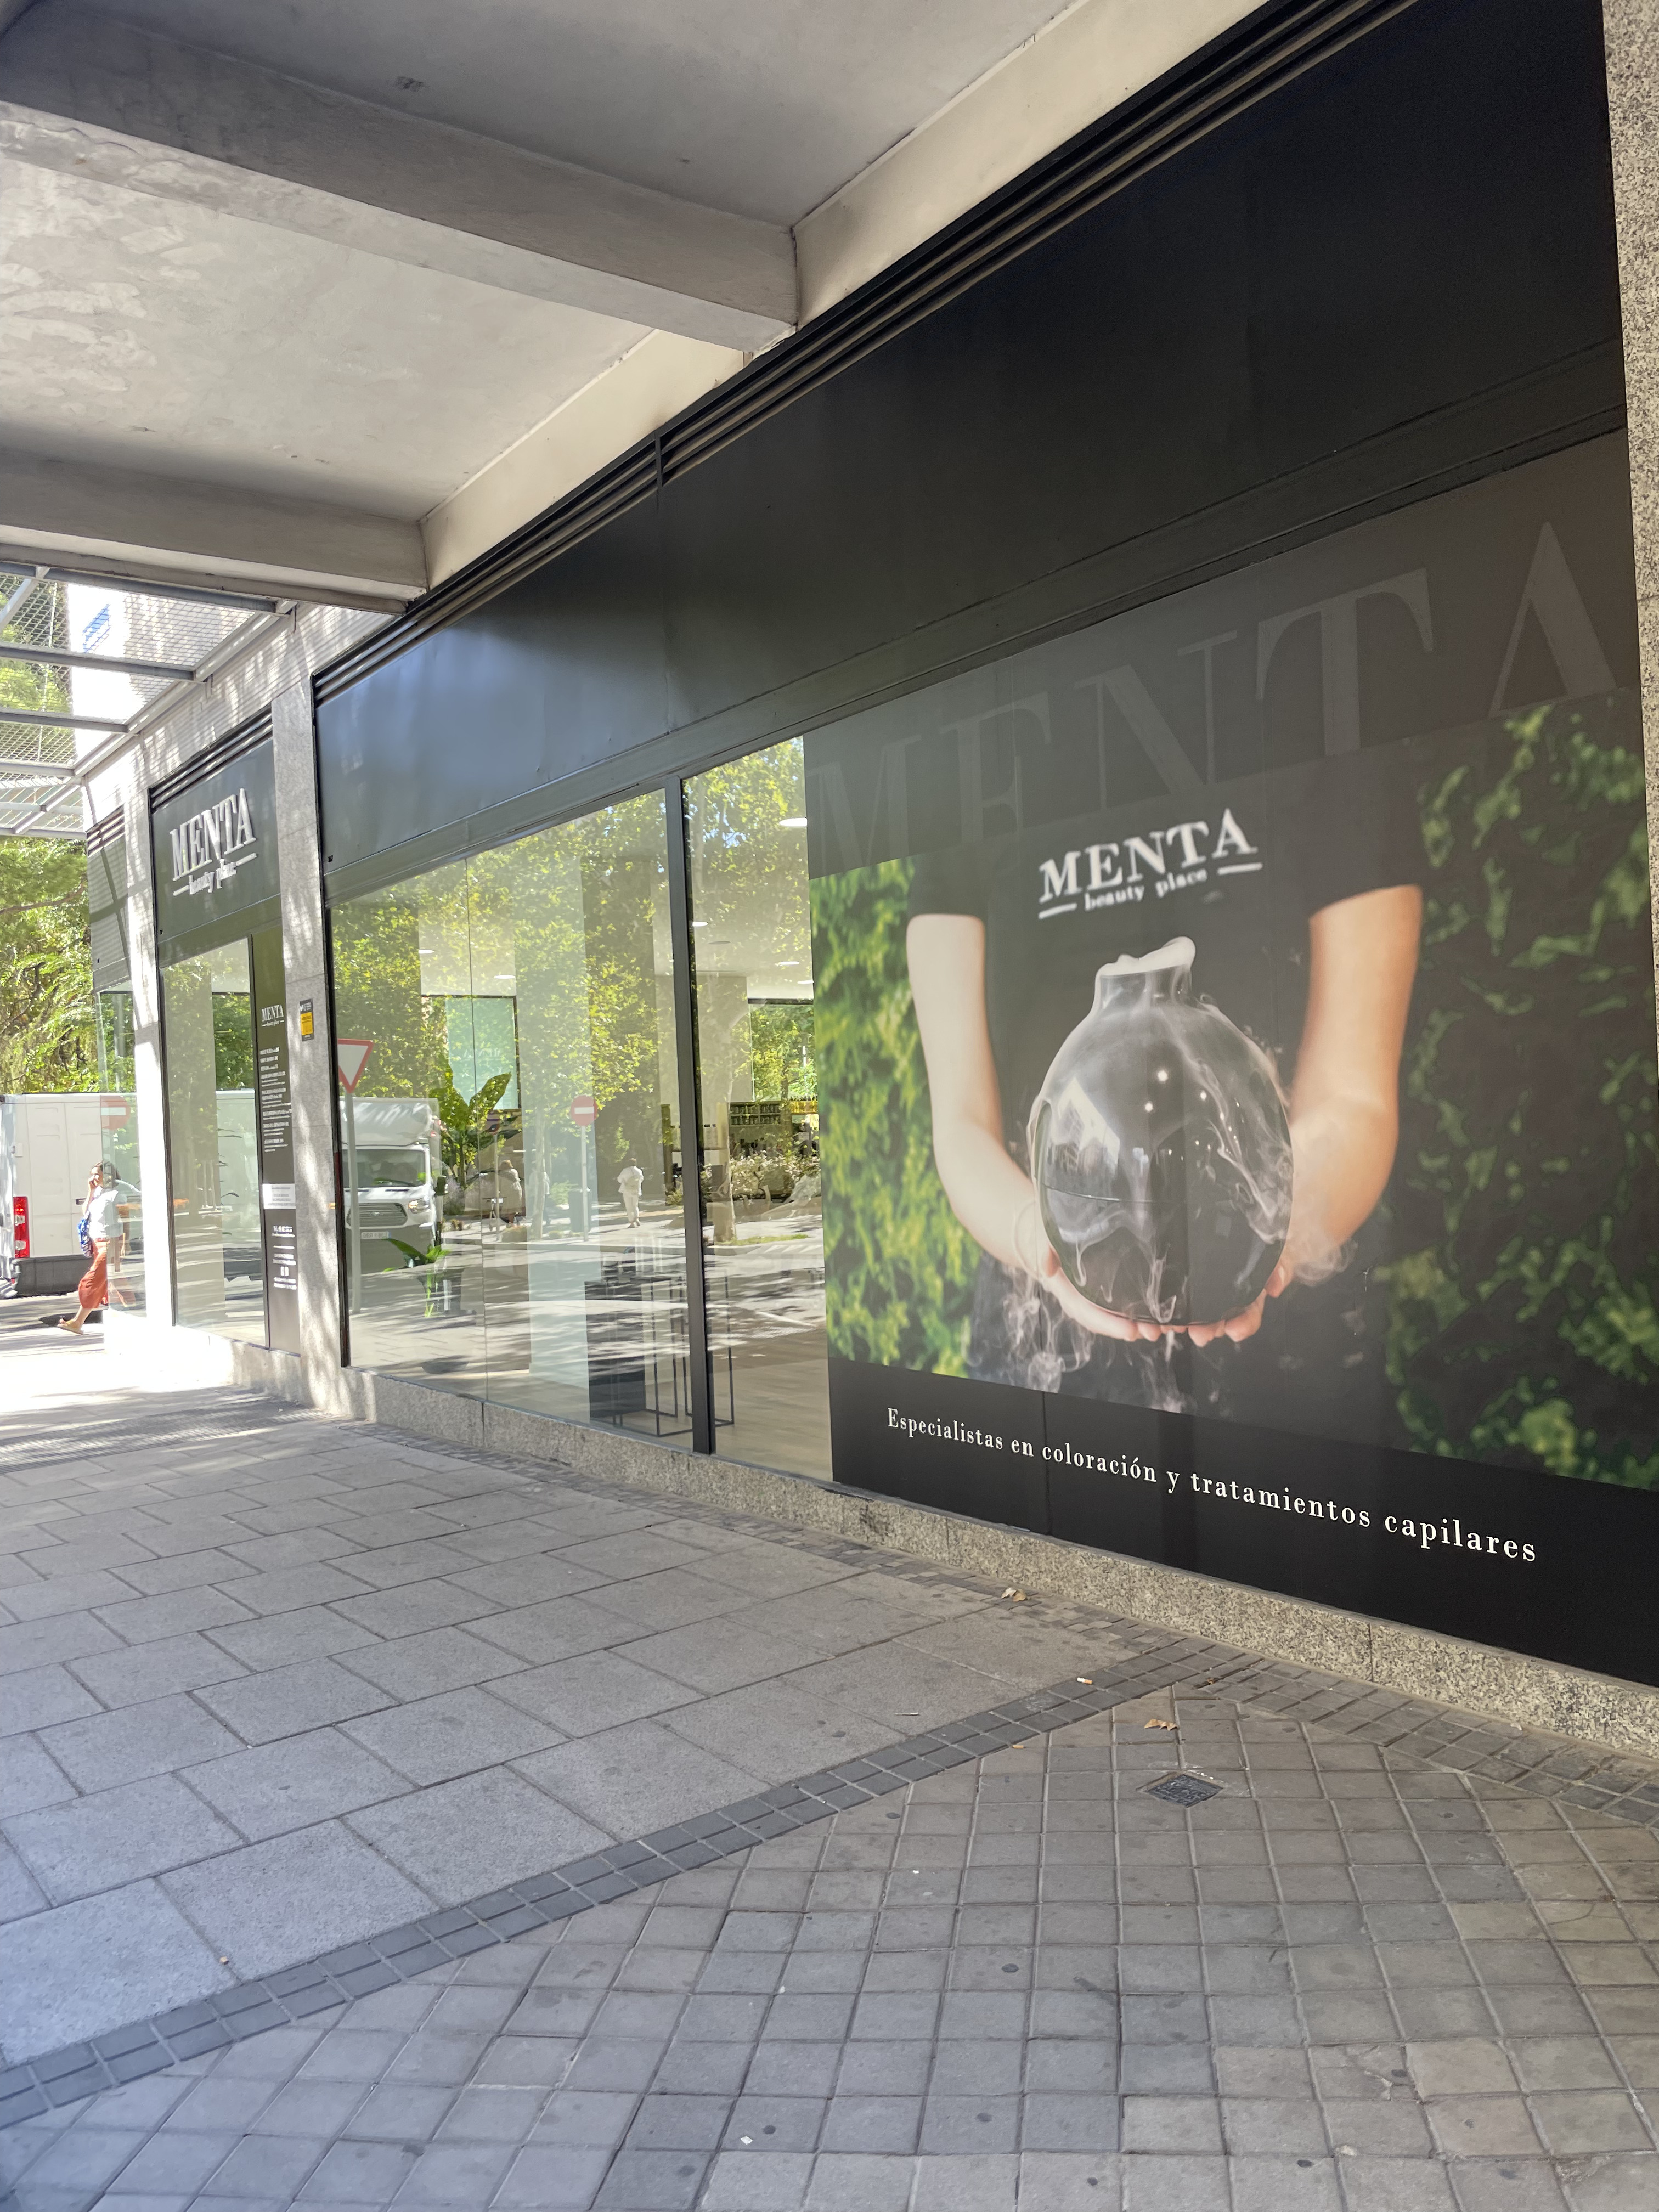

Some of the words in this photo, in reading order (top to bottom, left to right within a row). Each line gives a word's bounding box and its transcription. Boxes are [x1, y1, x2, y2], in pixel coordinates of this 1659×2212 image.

[806, 521, 1616, 872] MENTA
[170, 788, 257, 881] MENTA
[1039, 808, 1258, 904] MENTA
[1085, 886, 1145, 911] beauty
[1155, 868, 1207, 898] place
[262, 1004, 284, 1022] MENTA
[887, 1407, 1003, 1449] Especialistas
[1011, 1439, 1034, 1457] en
[1042, 1443, 1157, 1483] coloración
[1166, 1470, 1180, 1493] y
[1190, 1472, 1372, 1528] tratamientos
[1384, 1518, 1536, 1562] capilares
